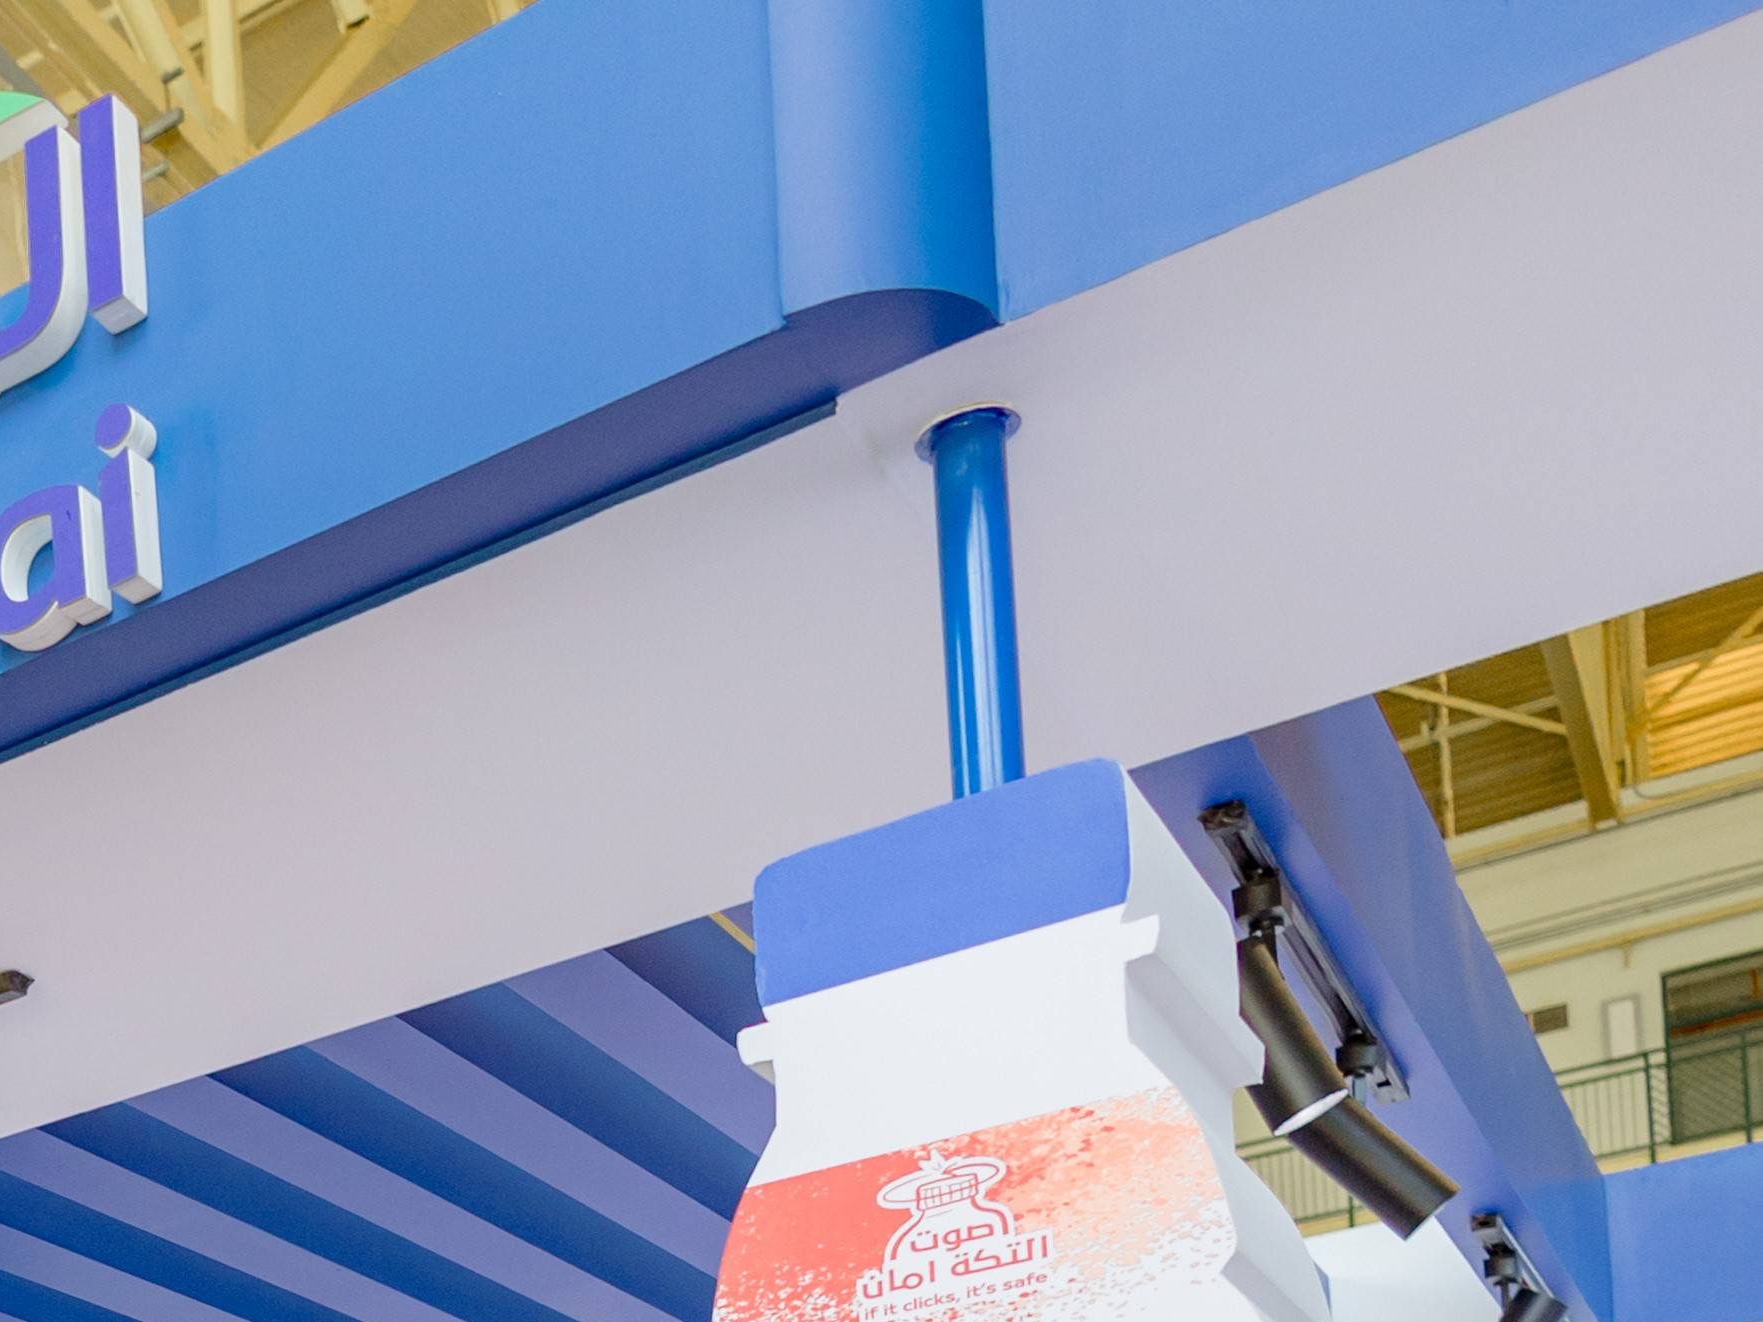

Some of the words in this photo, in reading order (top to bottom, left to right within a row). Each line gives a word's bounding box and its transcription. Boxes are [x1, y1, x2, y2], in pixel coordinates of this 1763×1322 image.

[910, 1223, 995, 1253] صوت
[950, 1235, 1048, 1276] التكة
[864, 1306, 879, 1321] if
[883, 1303, 898, 1317] it
[903, 1291, 961, 1313] clicks,
[1002, 1272, 1048, 1291] safe
